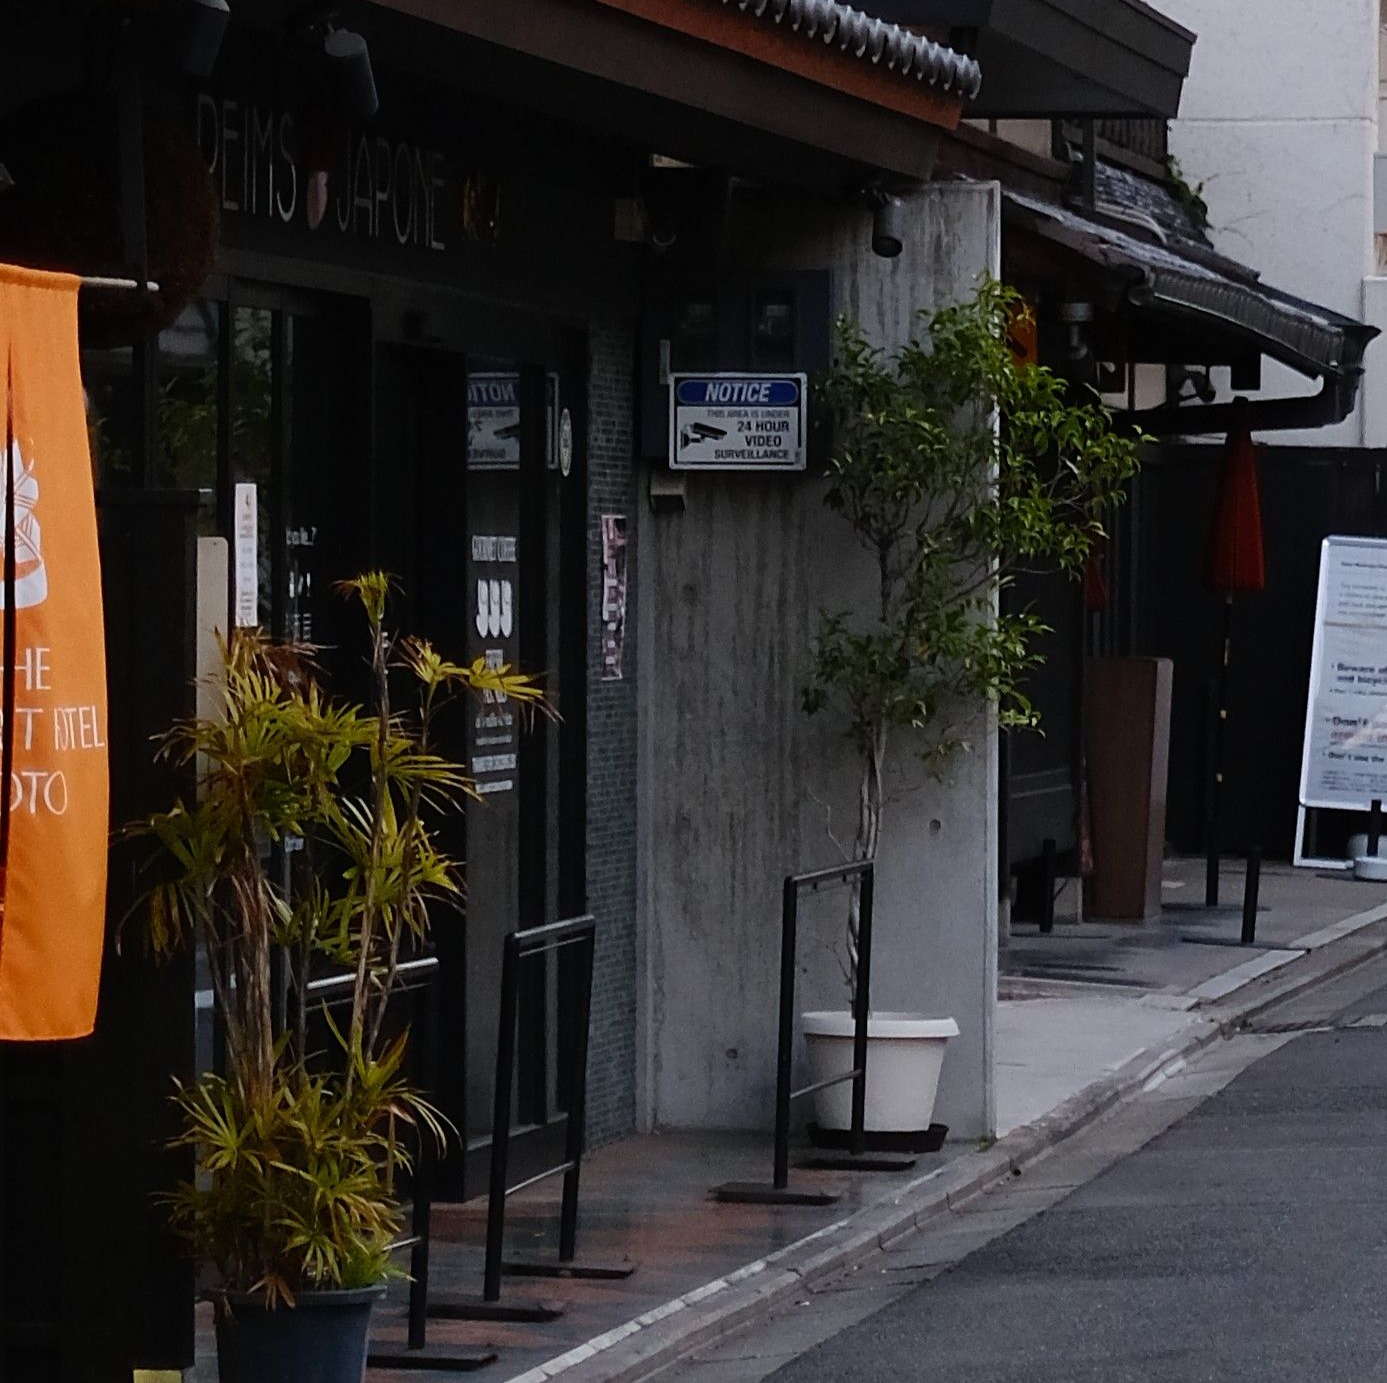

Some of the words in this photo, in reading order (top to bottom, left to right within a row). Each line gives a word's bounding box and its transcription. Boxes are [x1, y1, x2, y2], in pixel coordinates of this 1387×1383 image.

[705, 382, 771, 402] NOTICE
[727, 410, 749, 418] AREA
[737, 421, 752, 432] 24
[755, 421, 789, 432] HOUR
[745, 435, 782, 447] VIDEO
[714, 449, 789, 460] SURVEILLANCE
